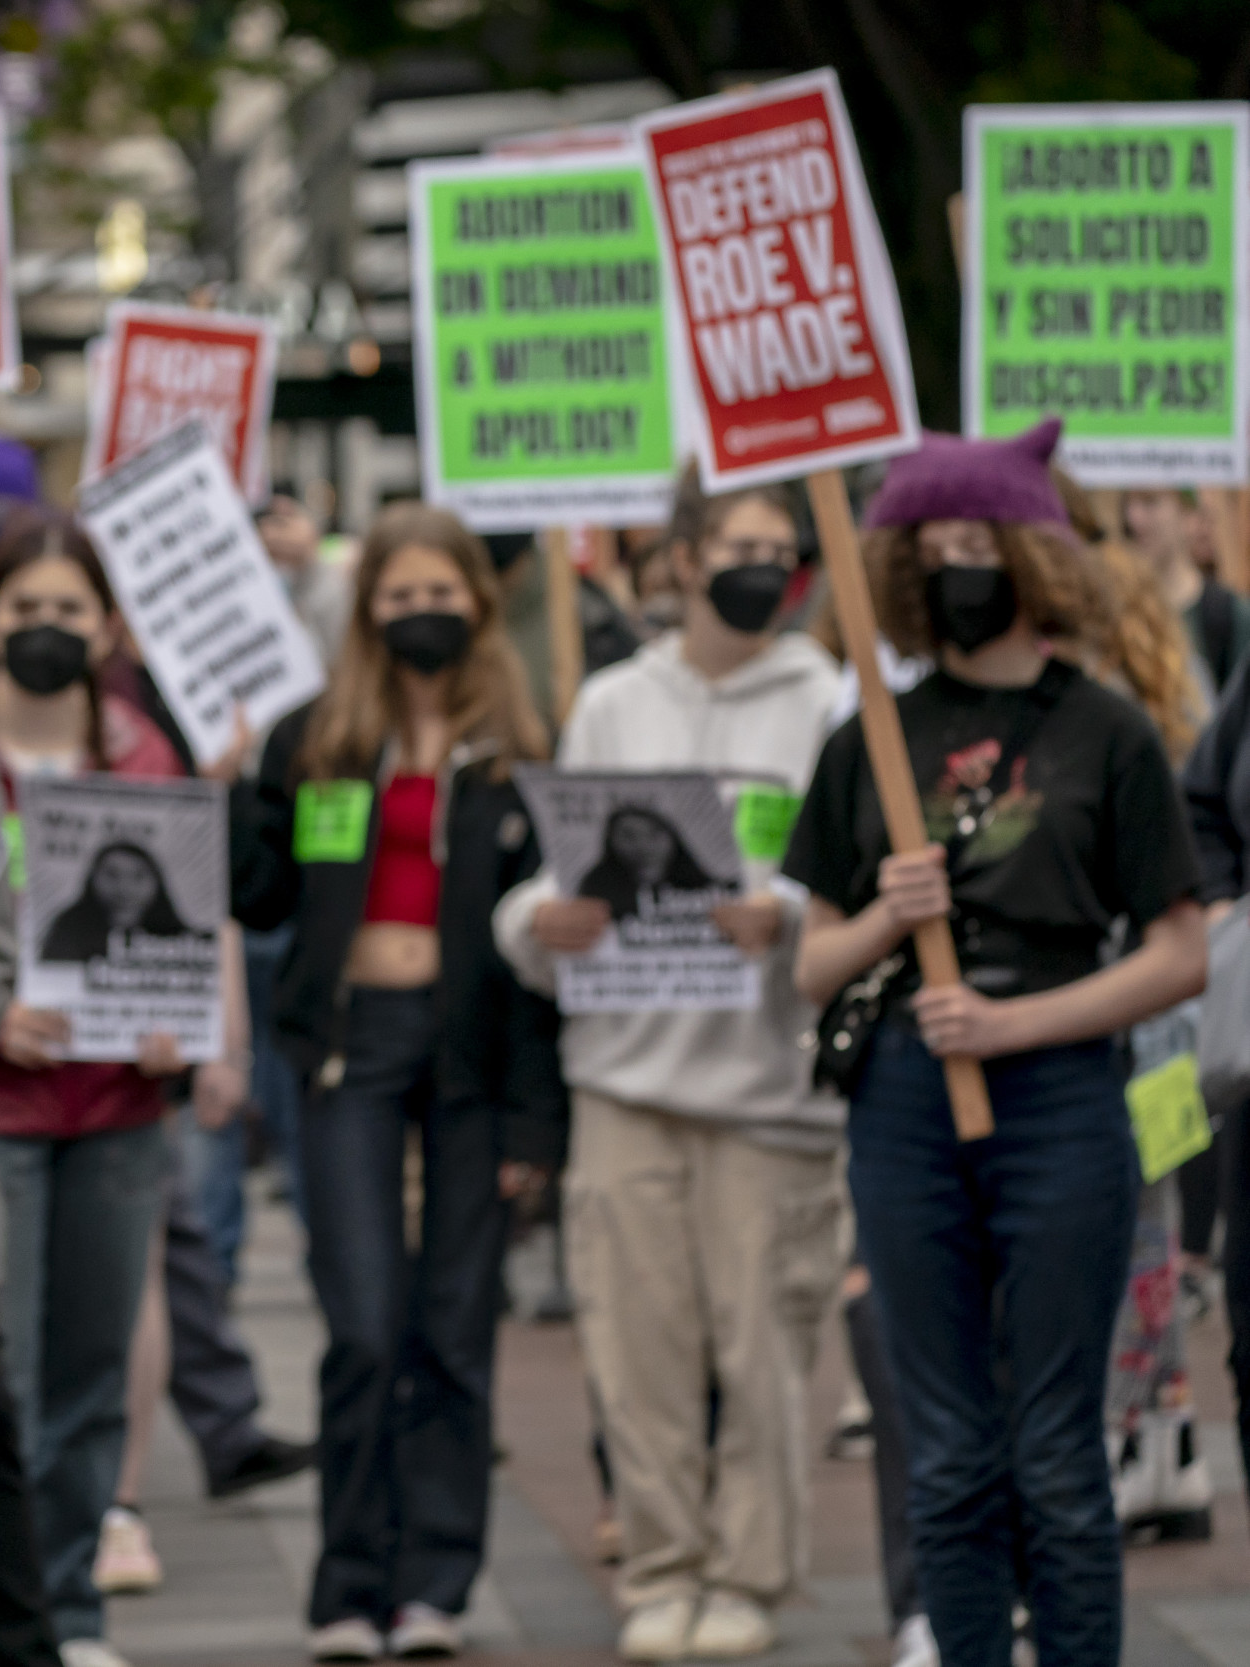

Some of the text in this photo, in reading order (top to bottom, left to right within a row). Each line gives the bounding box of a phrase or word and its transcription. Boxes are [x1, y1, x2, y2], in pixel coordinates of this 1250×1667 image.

[1188, 139, 1214, 192] A
[456, 187, 637, 244] ABORTION
[666, 148, 839, 241] DEFEND
[1006, 213, 1210, 266] SOLICITUD
[440, 259, 661, 318] ON DEMAND
[681, 216, 855, 322] ROE V.
[992, 287, 1225, 339] Y SIN PEDIR
[487, 331, 652, 386] WITHOUT
[696, 296, 875, 405] WADE
[991, 360, 1225, 412] DISCULPAS!
[472, 406, 641, 462] APOLOGY
